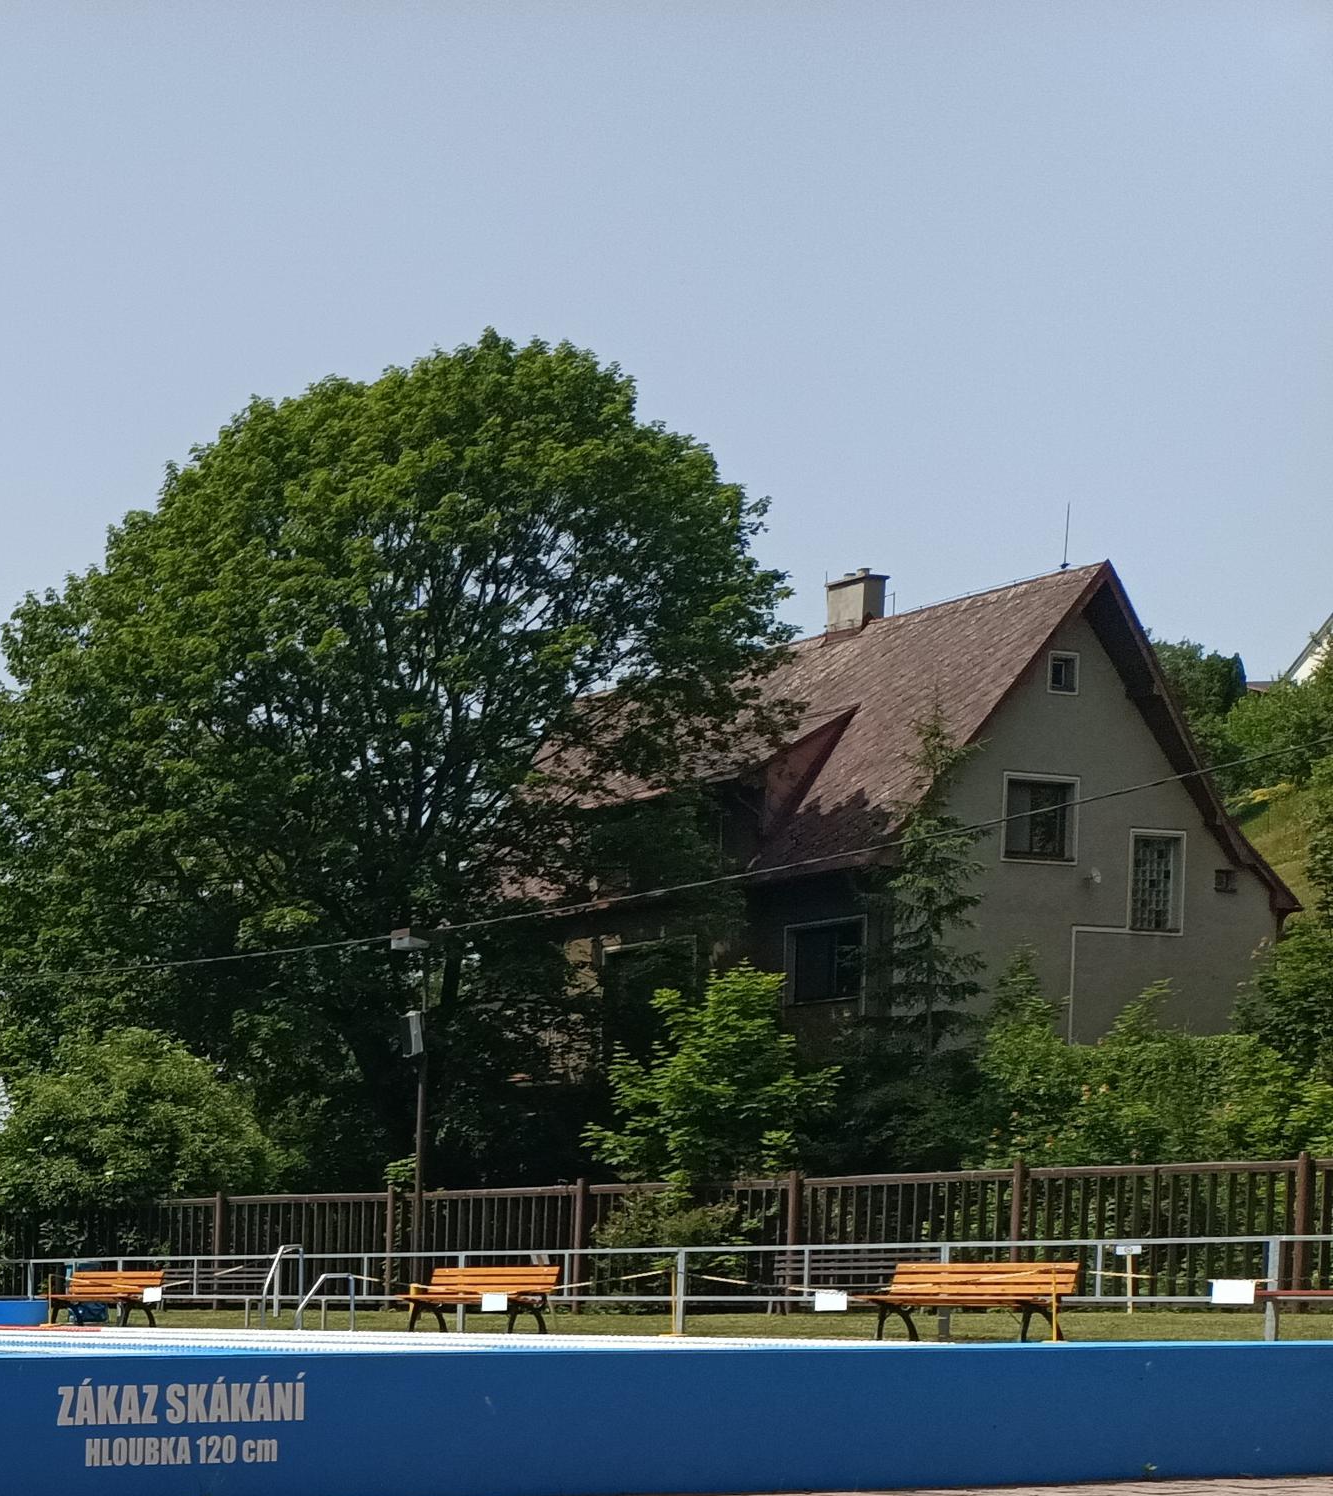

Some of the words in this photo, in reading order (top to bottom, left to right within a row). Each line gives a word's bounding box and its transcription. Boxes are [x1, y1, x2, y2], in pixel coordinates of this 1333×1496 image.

[57, 1378, 159, 1426] ZÁKAZ
[165, 1372, 306, 1425] SKÁKÁNÍ
[85, 1436, 191, 1467] HLOUBKA
[196, 1435, 237, 1465] 120
[242, 1438, 278, 1463] cm
